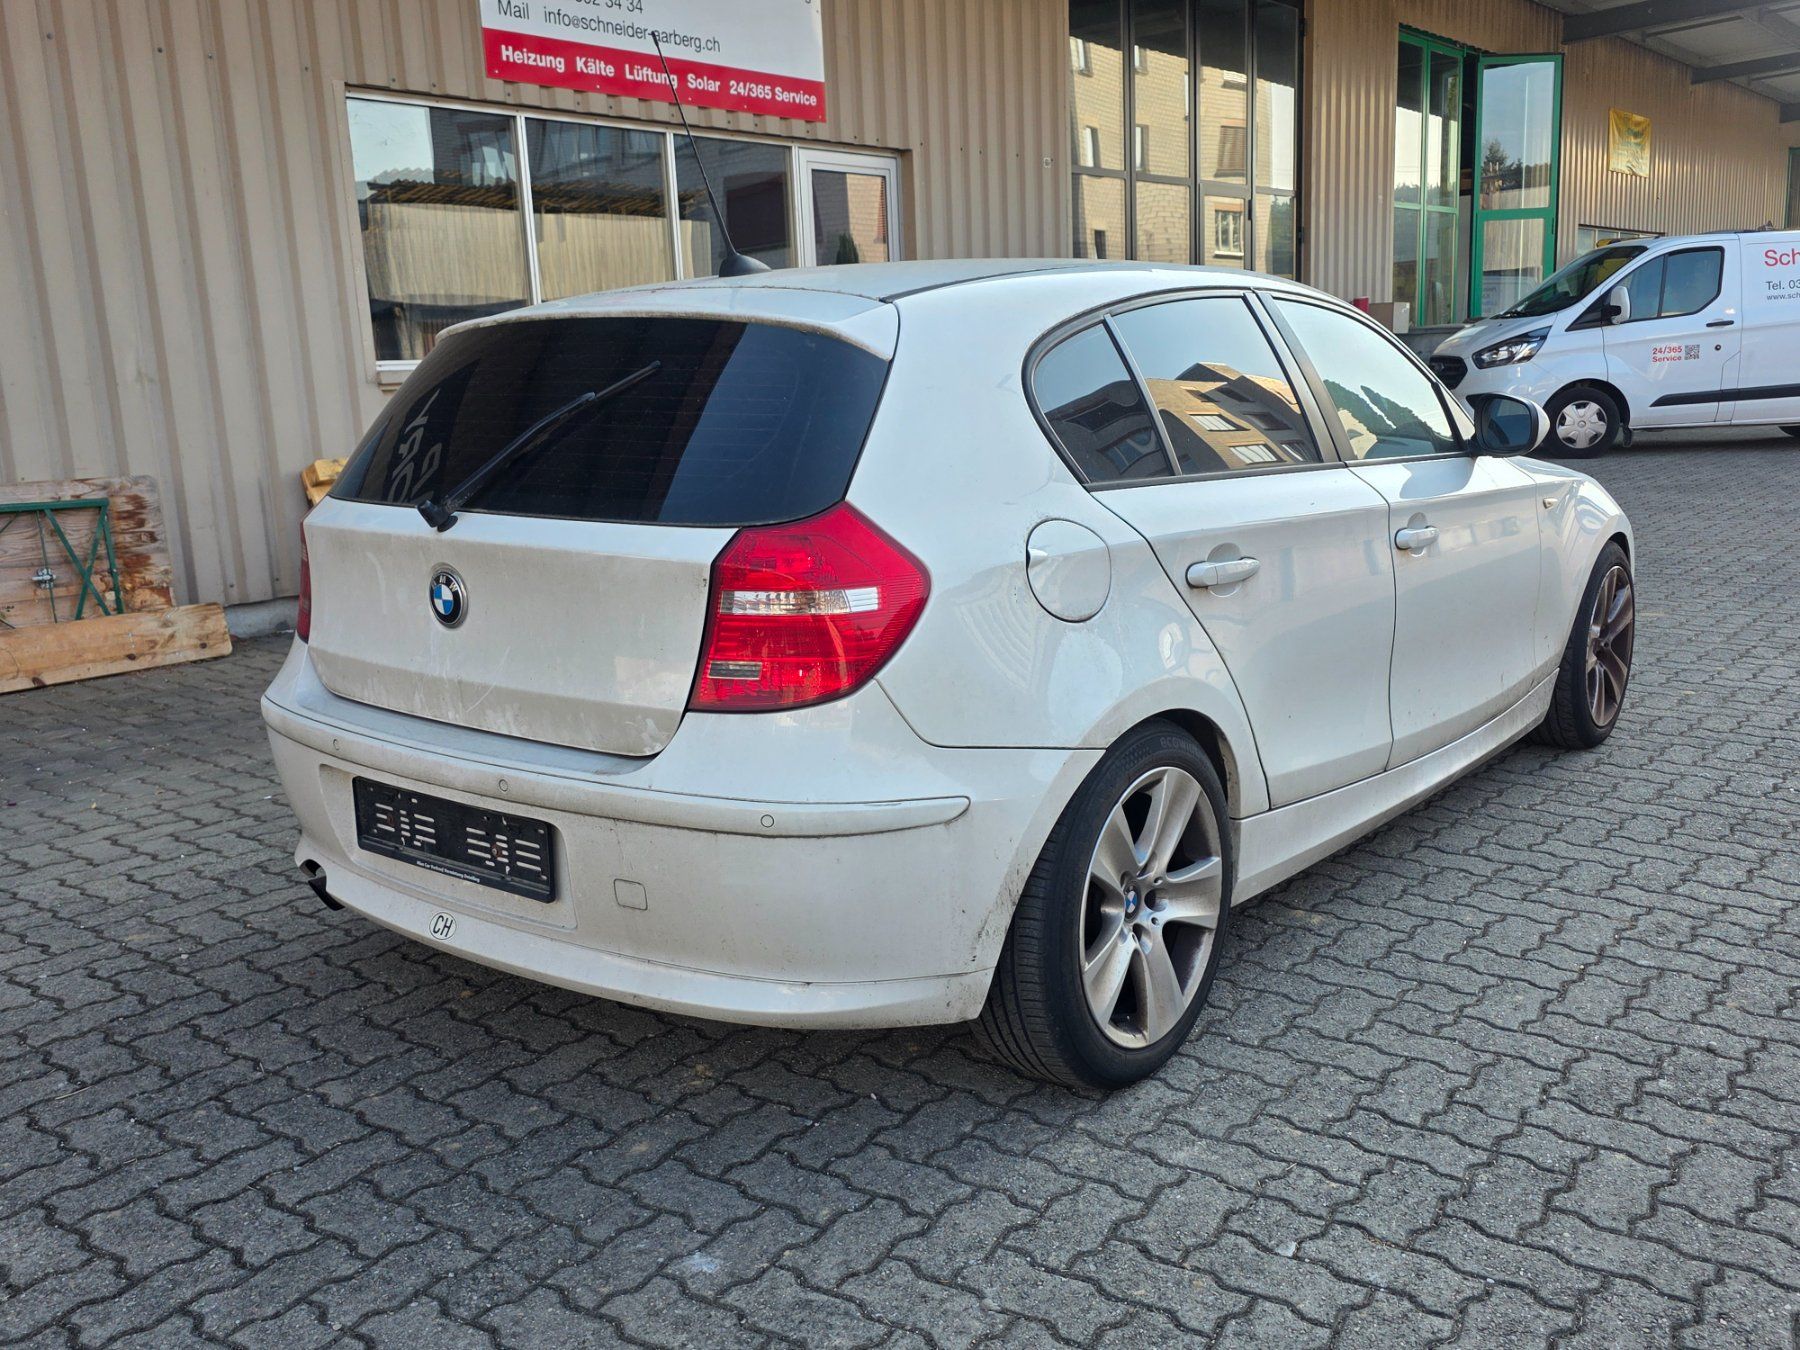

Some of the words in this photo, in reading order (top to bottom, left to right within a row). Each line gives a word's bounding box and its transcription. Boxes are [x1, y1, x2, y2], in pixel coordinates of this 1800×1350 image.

[497, 0, 530, 20] Mail
[626, 0, 643, 13] 34
[501, 44, 565, 73] Heizung
[576, 56, 615, 77] Kälte
[625, 64, 678, 90] Lüftung
[687, 73, 720, 92] Solar
[729, 80, 772, 100] 24/365
[774, 86, 817, 106] Service
[1765, 280, 1785, 291] Tel.
[1652, 345, 1683, 355] 24/365
[1652, 355, 1682, 363] Service
[432, 914, 454, 938] CH
